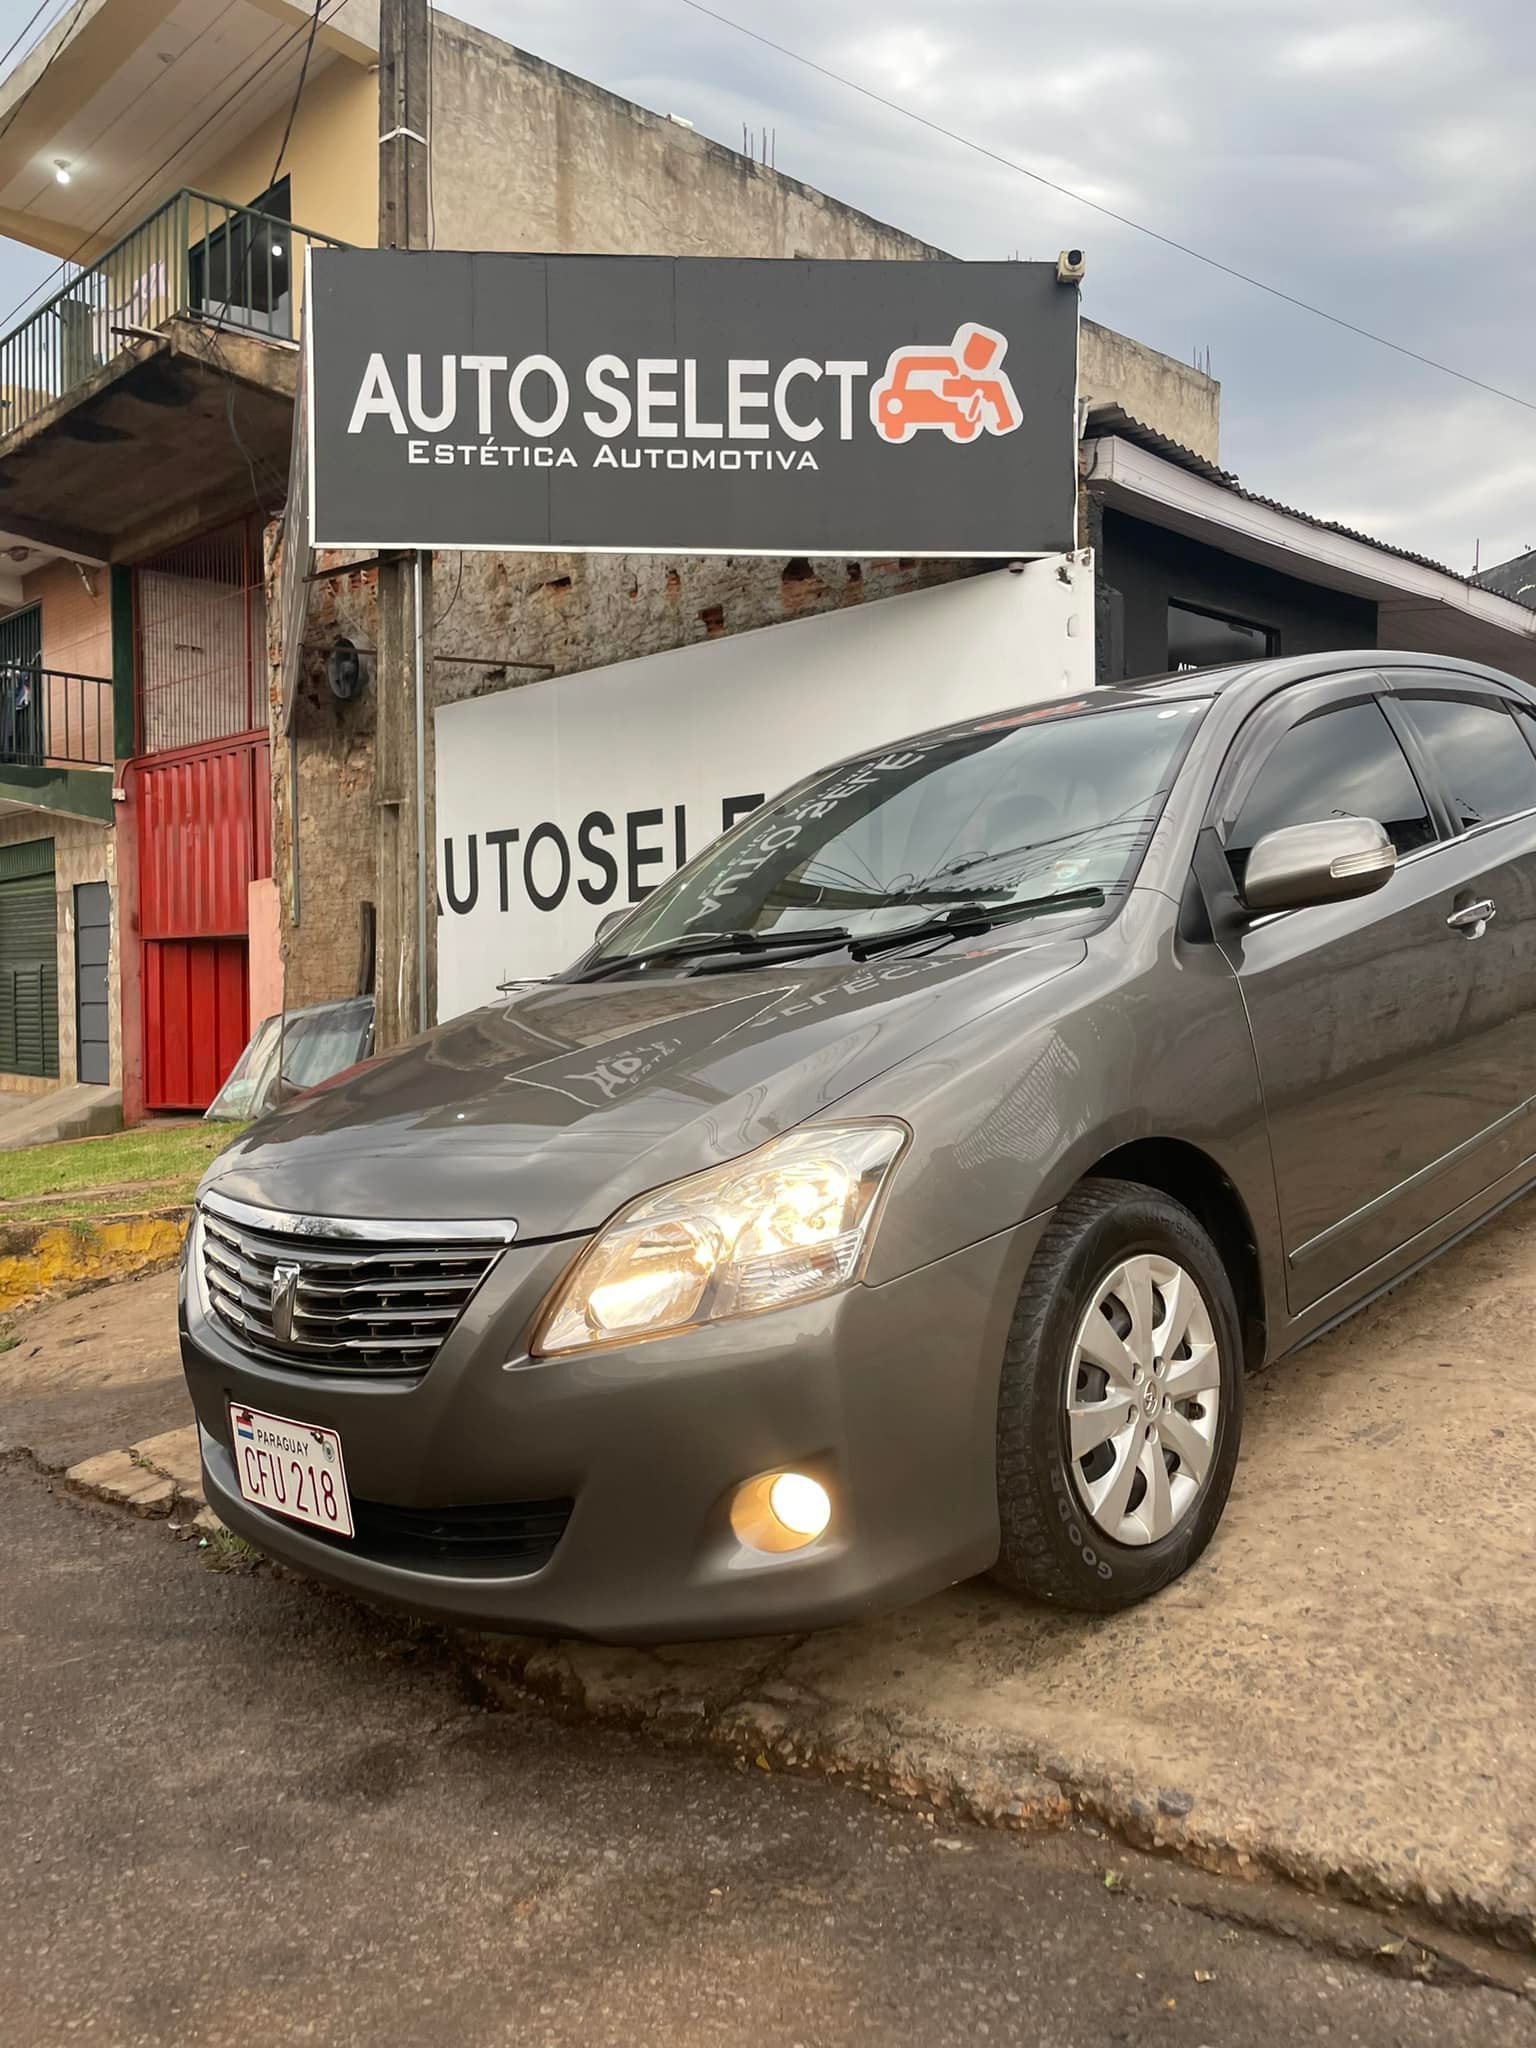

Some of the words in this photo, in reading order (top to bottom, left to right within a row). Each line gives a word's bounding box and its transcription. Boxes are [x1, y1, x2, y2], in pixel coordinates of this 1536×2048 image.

[347, 353, 569, 438] AUTO
[583, 354, 868, 442] SELECT
[408, 436, 578, 467] ESTÉTICA
[592, 444, 819, 470] AUTOMOTIVA
[257, 1429, 309, 1457] PARAGUAY
[245, 1446, 287, 1504] CFU
[291, 1461, 338, 1521] 218
